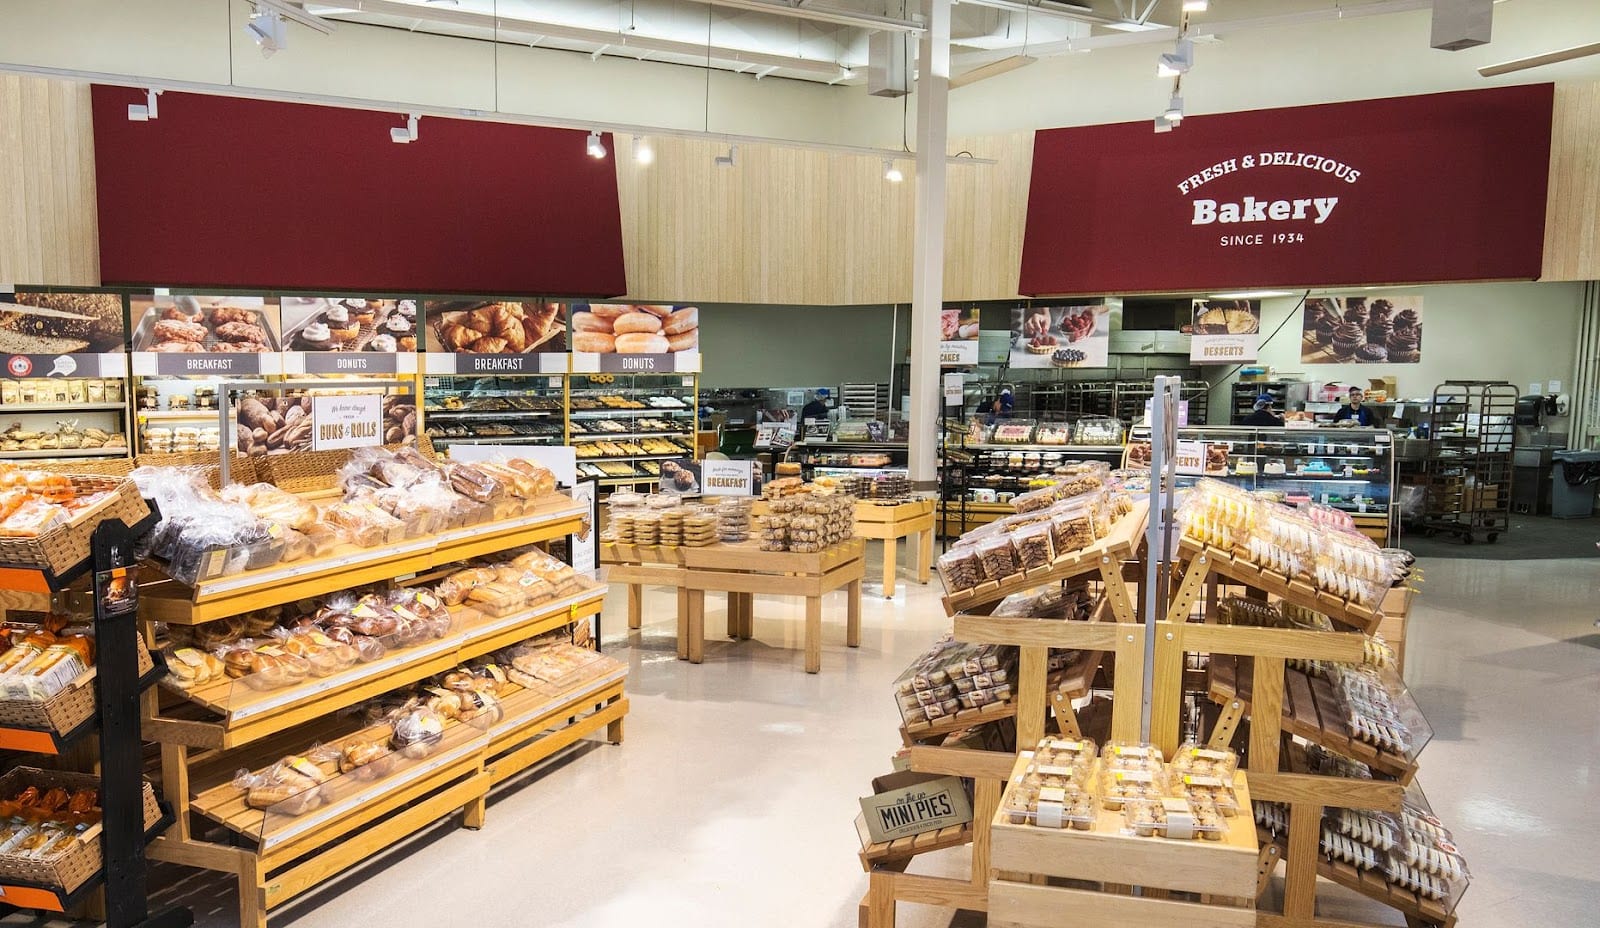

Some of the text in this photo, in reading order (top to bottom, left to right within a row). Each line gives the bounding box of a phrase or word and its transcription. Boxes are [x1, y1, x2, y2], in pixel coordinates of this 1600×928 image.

[1177, 152, 1362, 195] FRESH & DELICIOUS
[1191, 196, 1339, 225] Bakery
[1219, 232, 1305, 246] SINCE 1934
[1204, 346, 1244, 356] DESSERTS
[186, 358, 233, 370] BREAKFAST
[336, 357, 367, 370] DONUTS
[474, 358, 523, 370] BREAKFAST
[622, 357, 655, 370] DONUTS
[320, 423, 344, 441] BUNS
[351, 421, 377, 438] ROLLS
[707, 477, 748, 489] BREAKFAST
[880, 793, 953, 830] MINI PIES
